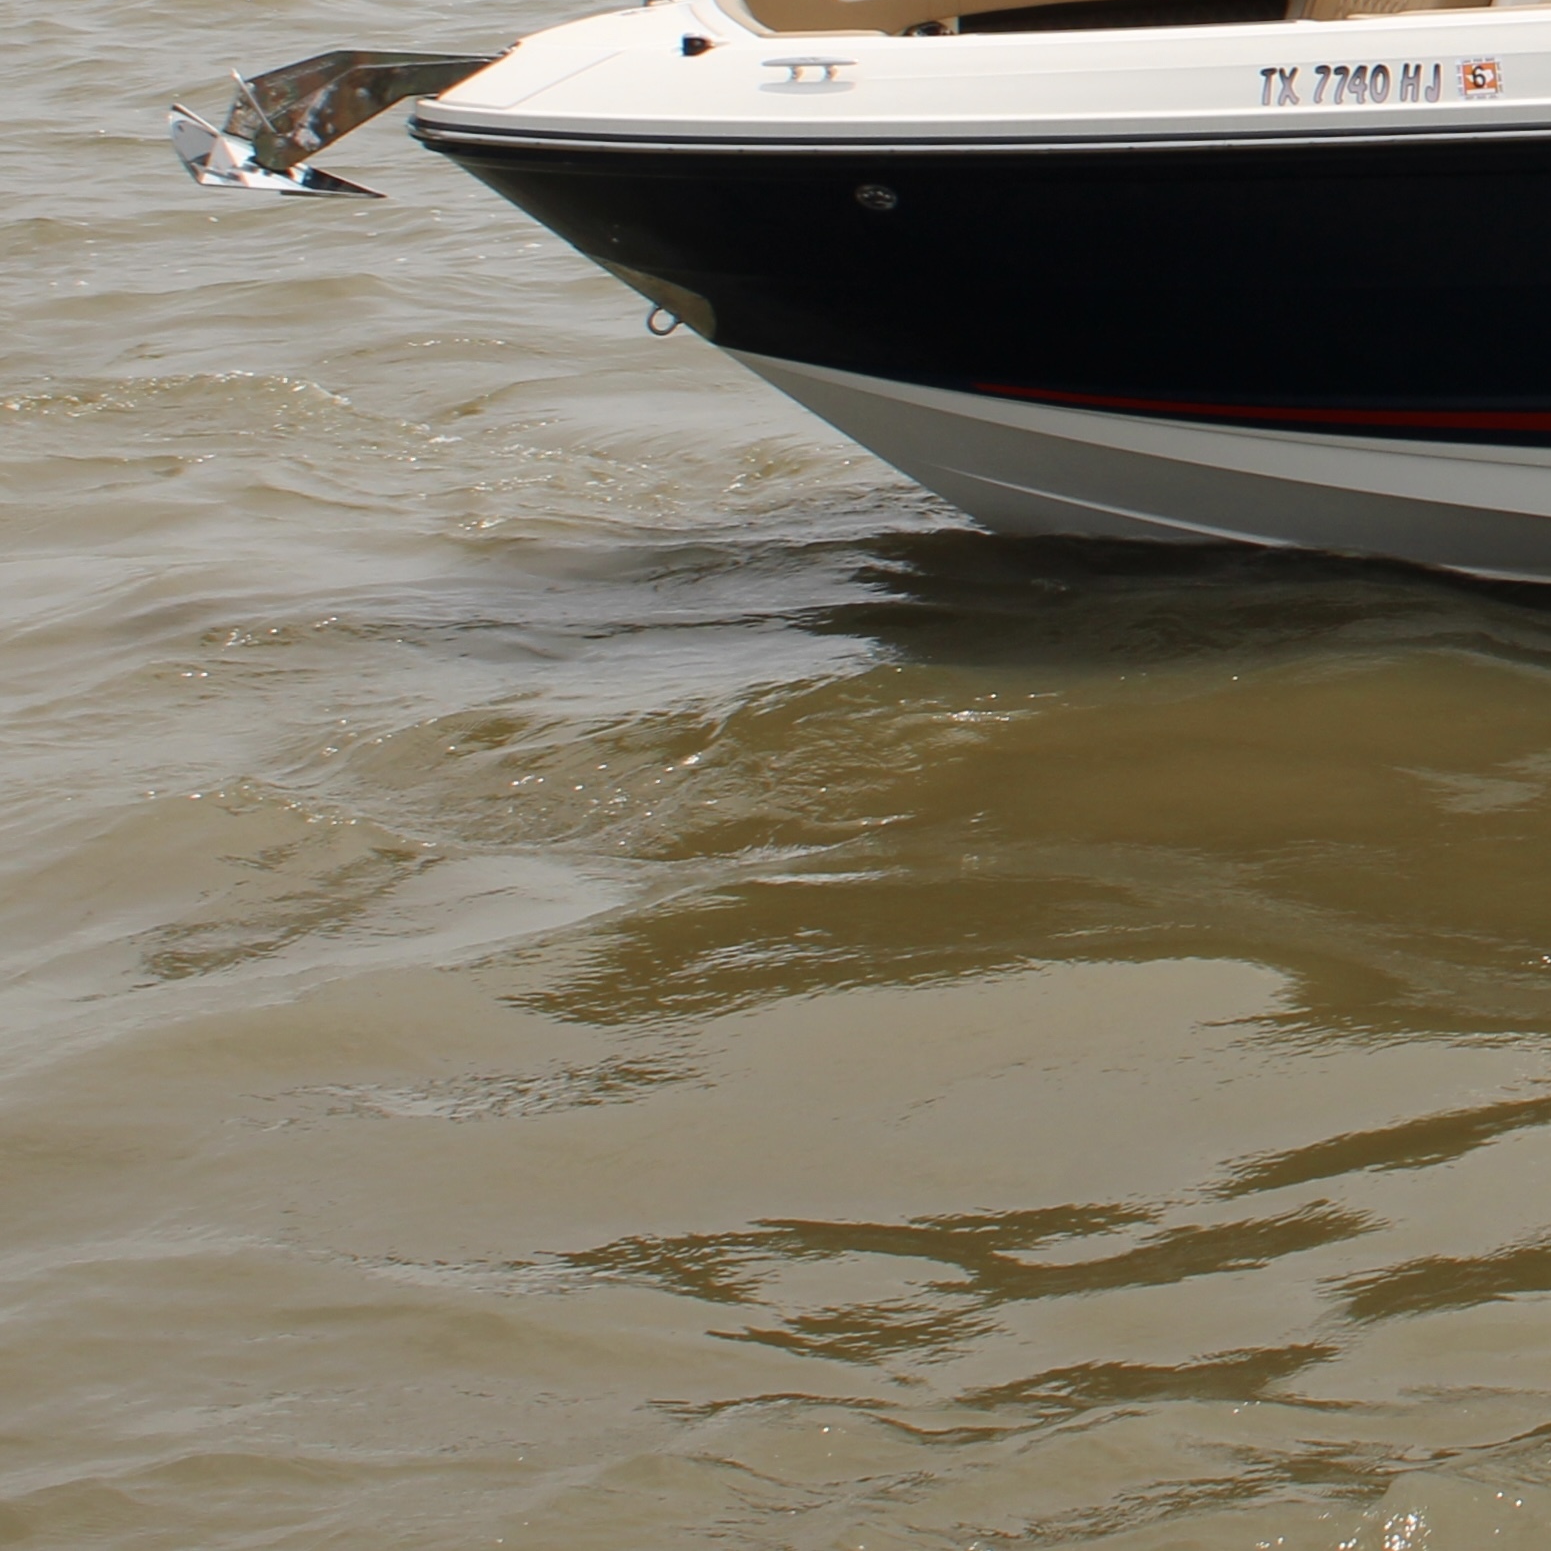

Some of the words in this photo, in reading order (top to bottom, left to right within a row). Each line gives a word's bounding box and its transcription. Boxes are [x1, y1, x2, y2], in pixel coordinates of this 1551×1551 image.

[1260, 66, 1299, 105] TX
[1313, 64, 1391, 103] 7740
[1472, 65, 1486, 88] 6
